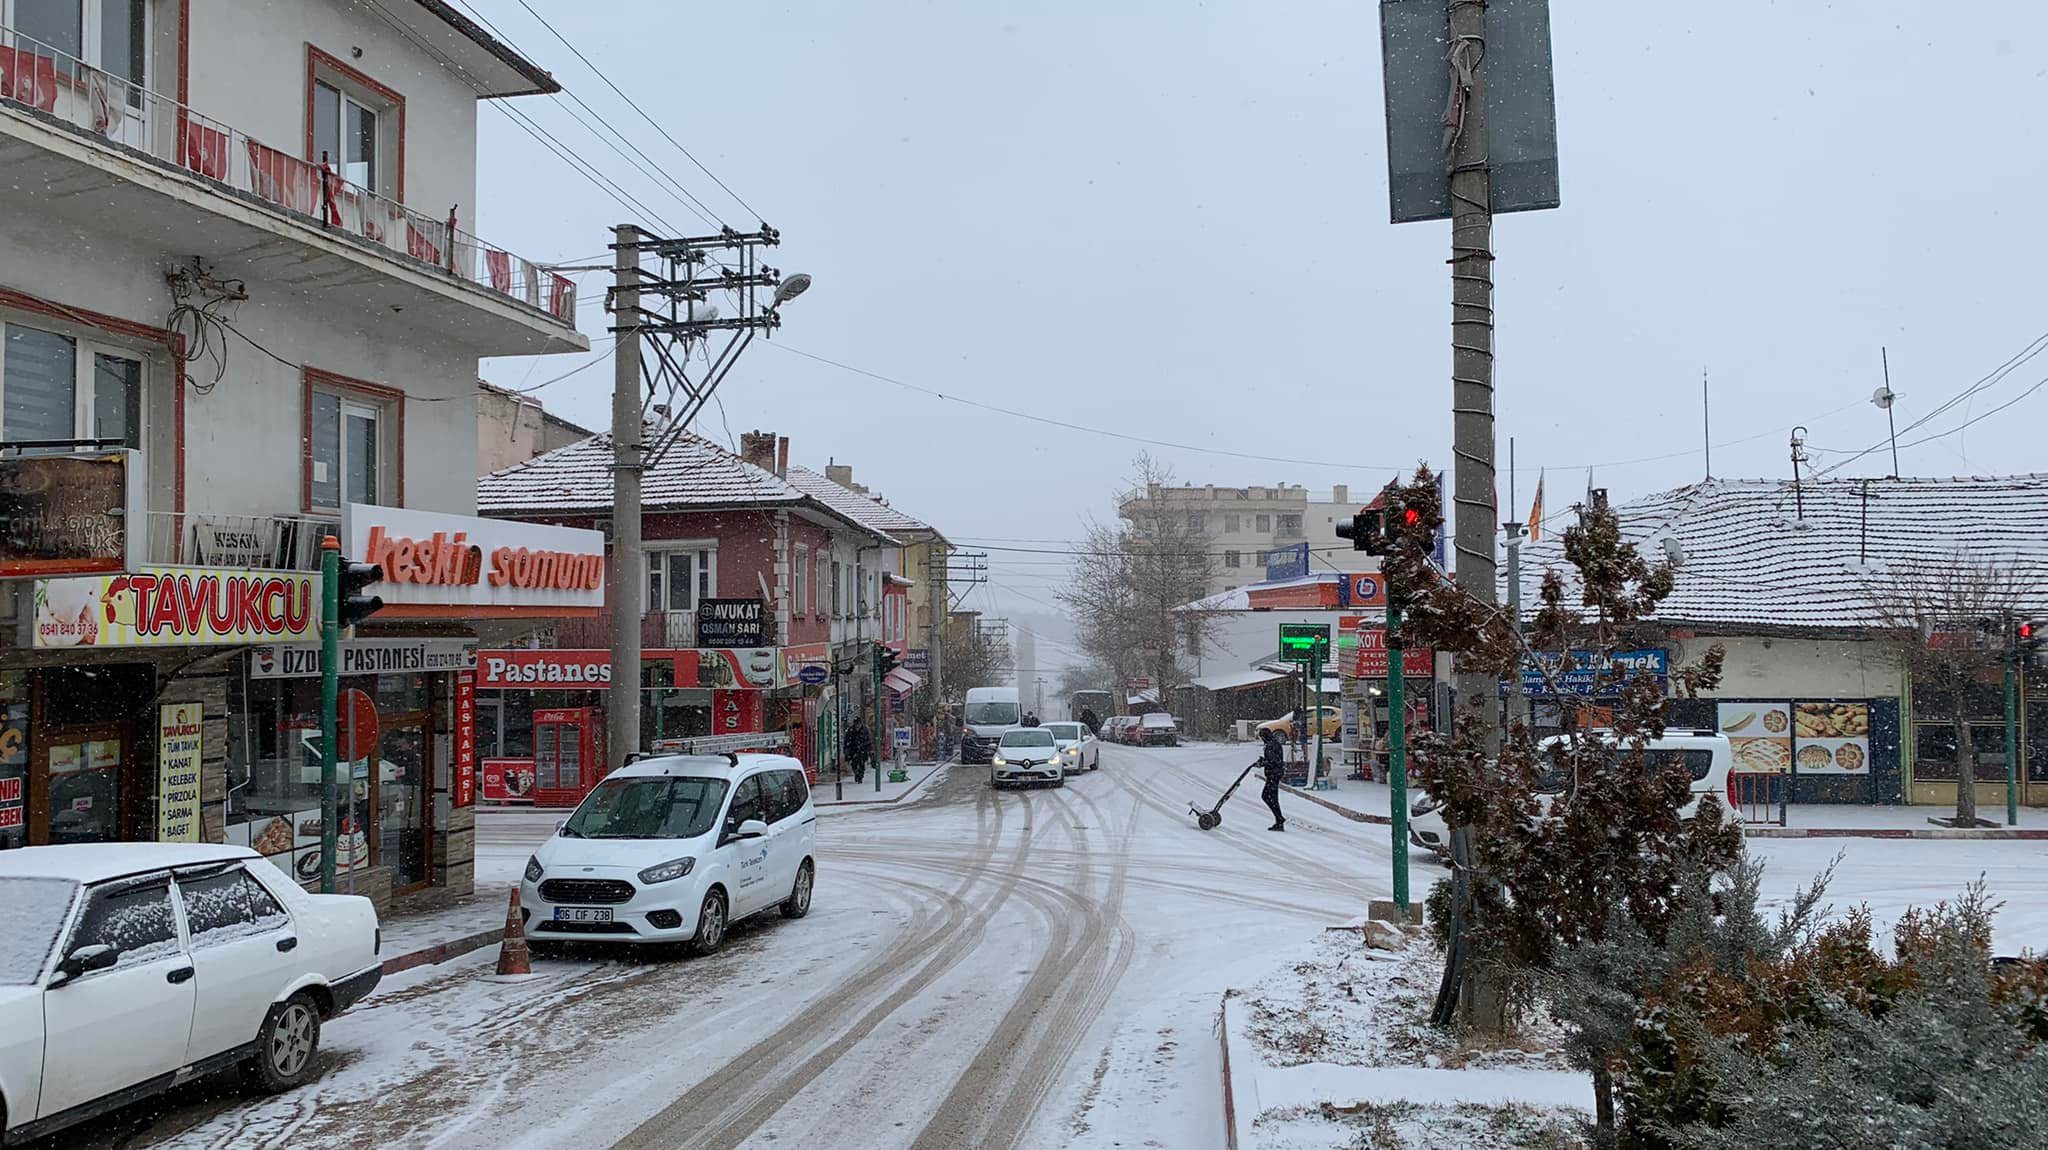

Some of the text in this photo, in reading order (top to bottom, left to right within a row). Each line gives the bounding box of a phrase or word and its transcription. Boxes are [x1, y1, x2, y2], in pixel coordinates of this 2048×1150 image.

[488, 547, 602, 590] somunu
[130, 573, 312, 635] TAVUKCU
[714, 603, 761, 619] AVUKAT
[737, 623, 760, 634] SARI
[344, 644, 425, 672] PASTANESİ
[486, 658, 611, 684] Pastanes
[461, 686, 474, 802] PASTANESİ
[167, 757, 192, 769] KANAT
[167, 773, 197, 786] KELEBEK
[167, 807, 192, 820] SARMA
[167, 823, 190, 837] BAGET
[560, 909, 610, 921] 06 CIF 238
